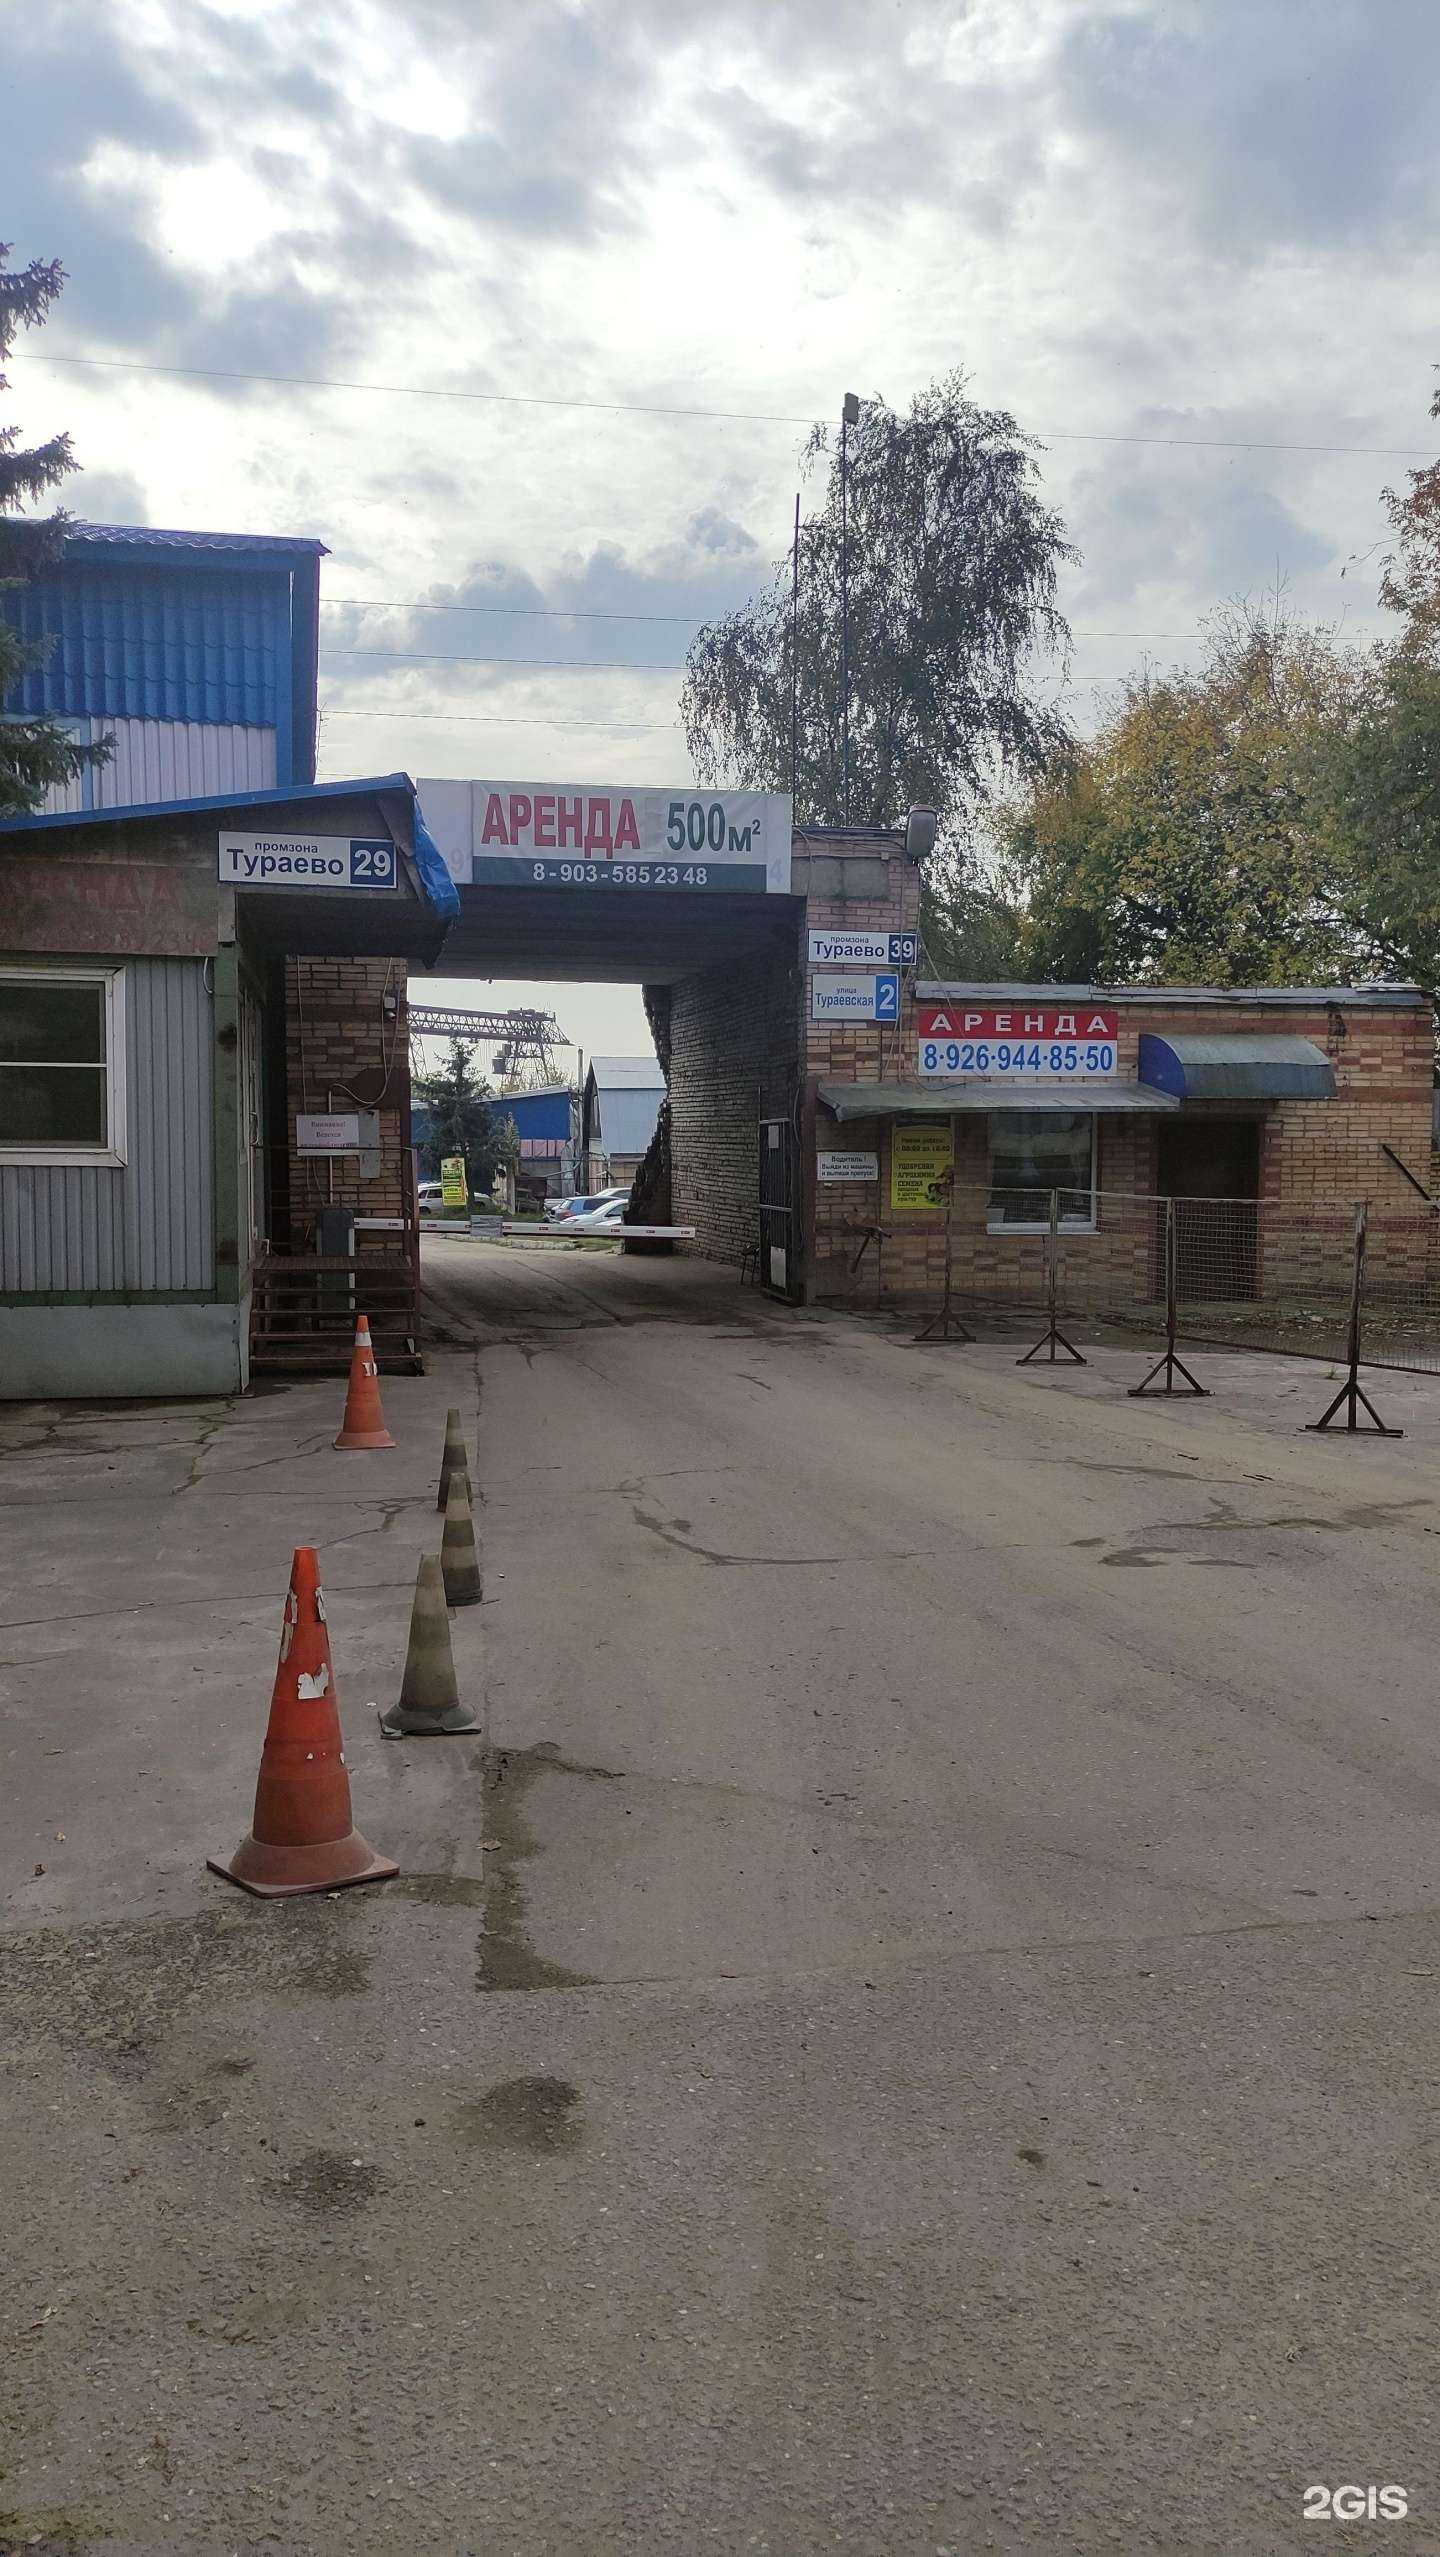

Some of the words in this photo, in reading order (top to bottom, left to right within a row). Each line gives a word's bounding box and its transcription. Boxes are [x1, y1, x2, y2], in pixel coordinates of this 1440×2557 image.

[481, 793, 641, 859] АРЕНДА
[254, 841, 319, 854] промзона
[227, 848, 344, 877] Тураево
[354, 850, 391, 877] 29
[813, 941, 885, 959] Тураево
[891, 940, 914, 958] 39
[830, 936, 870, 945] промзона
[816, 993, 874, 1008] Тураевская
[879, 984, 895, 1010] 2
[836, 987, 857, 995] улица
[930, 1013, 1109, 1036] АРЕНДА
